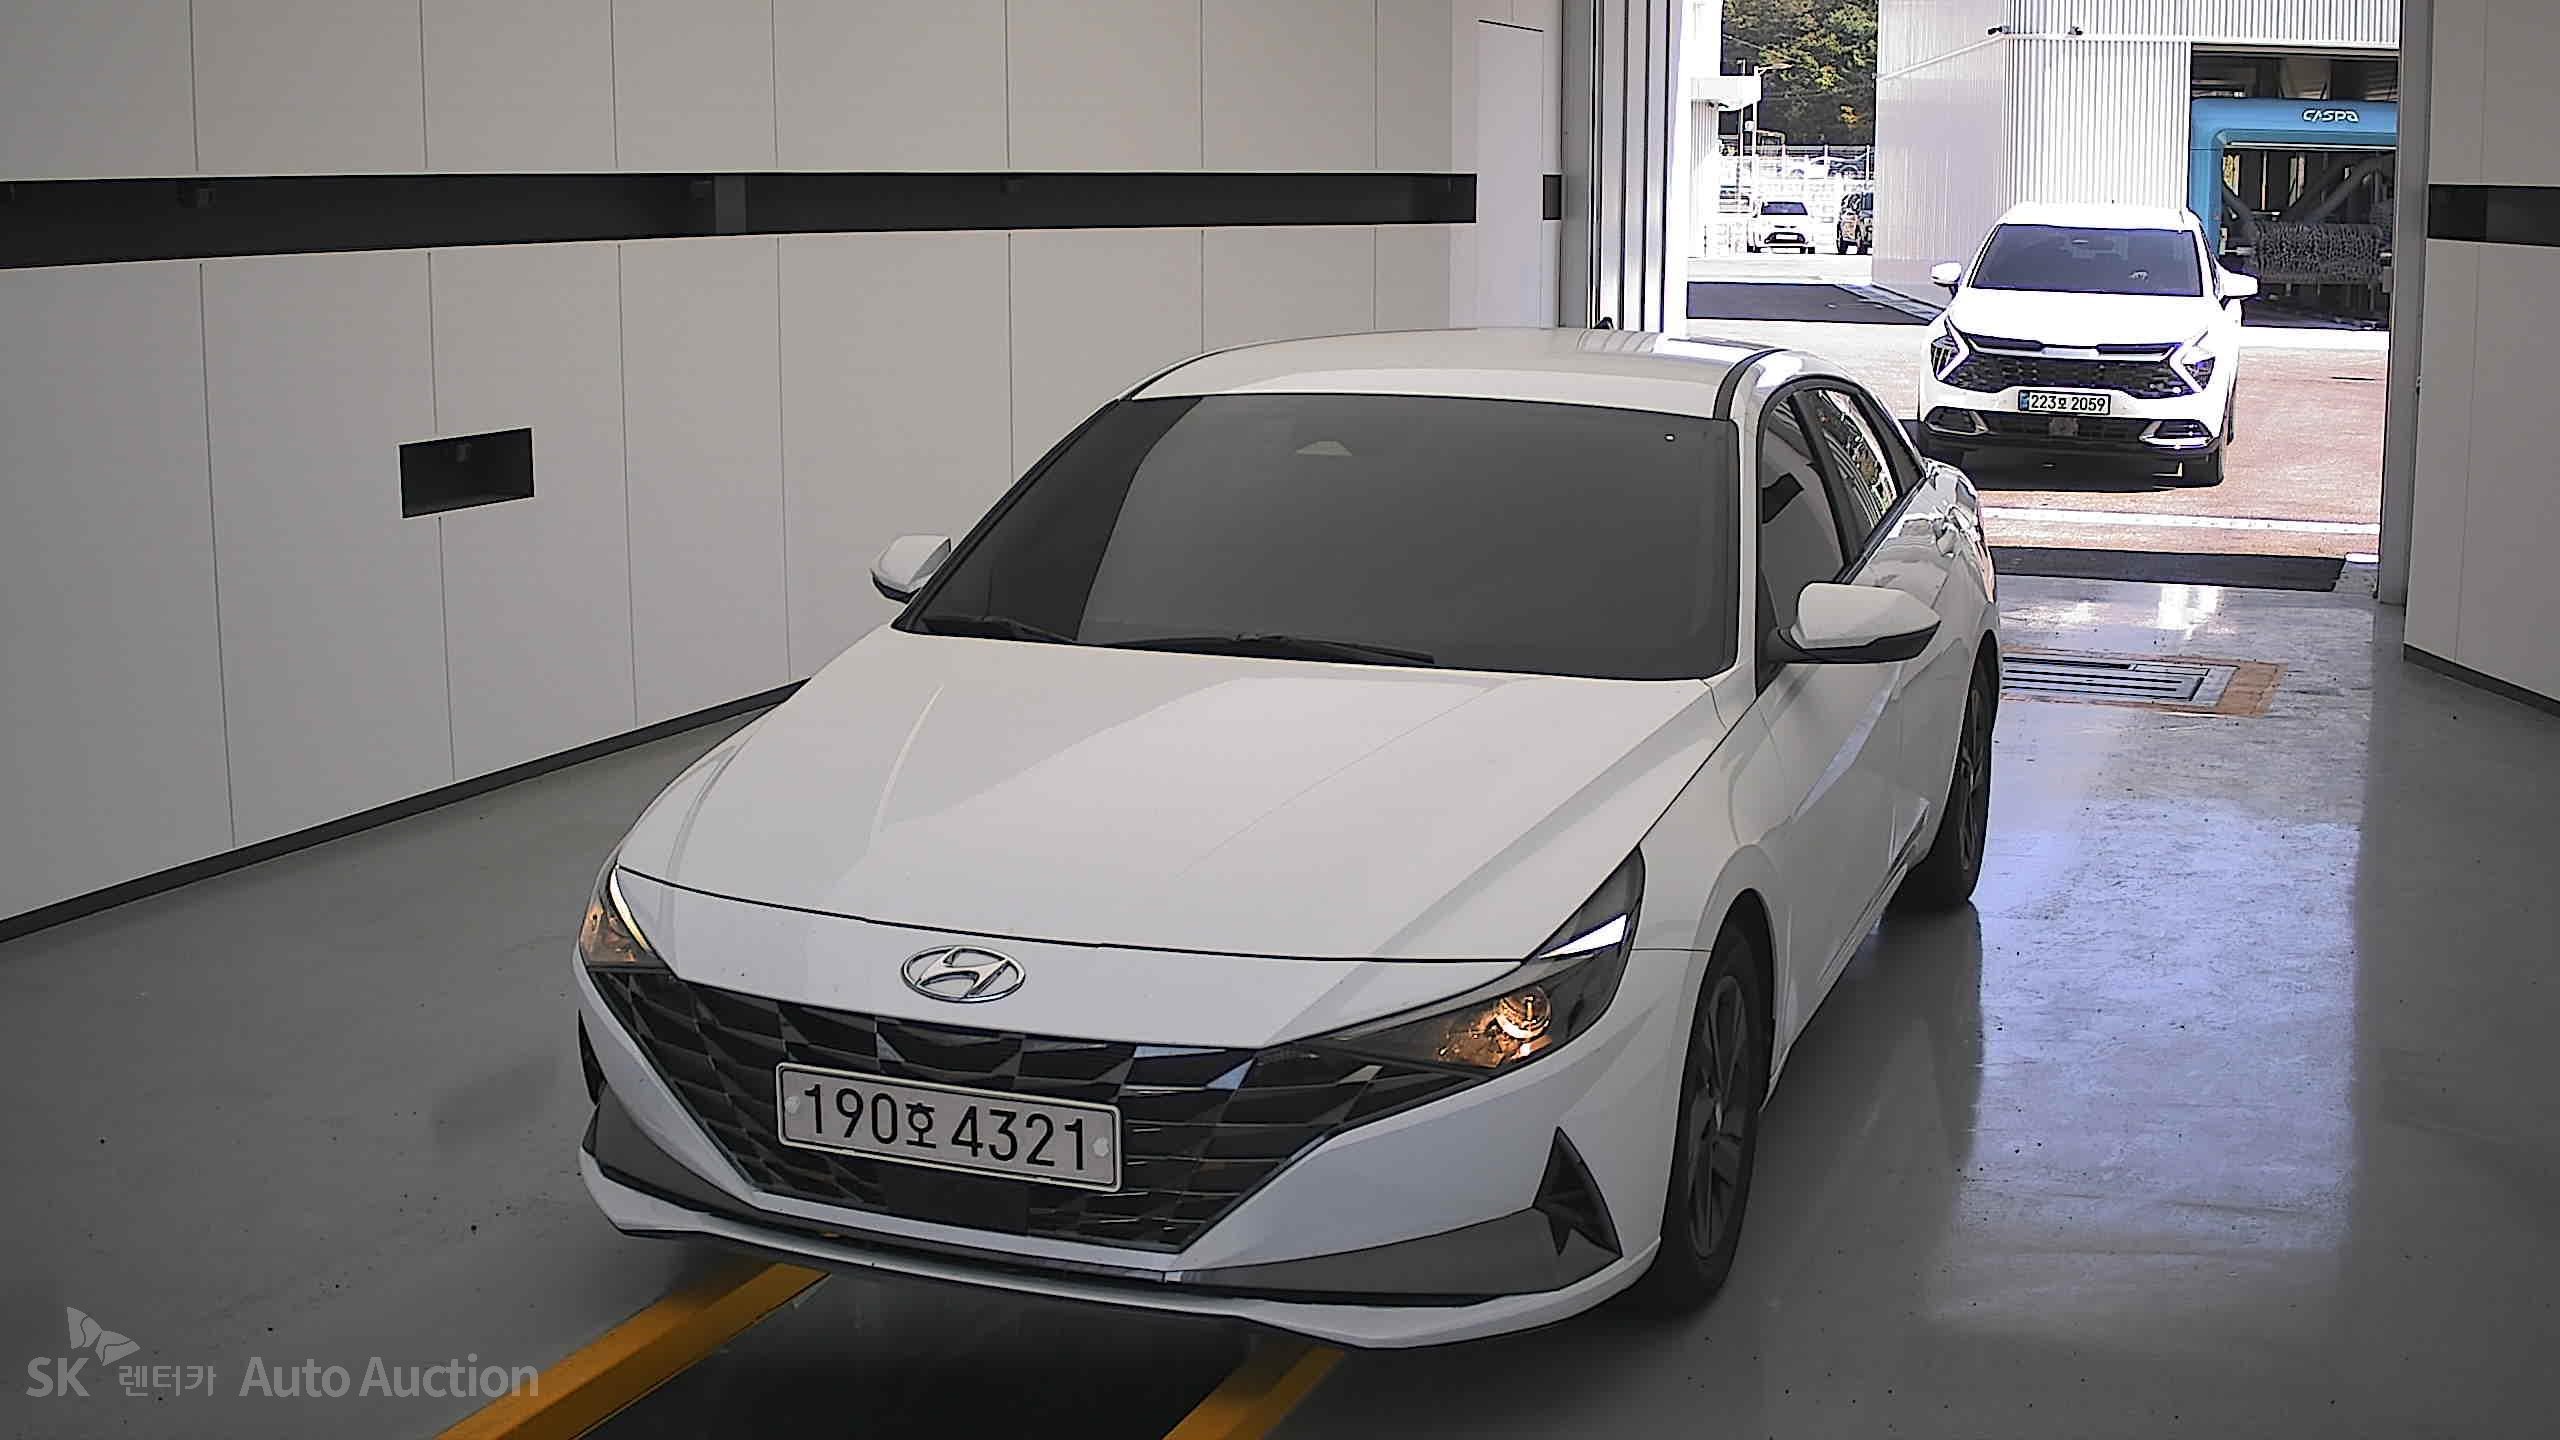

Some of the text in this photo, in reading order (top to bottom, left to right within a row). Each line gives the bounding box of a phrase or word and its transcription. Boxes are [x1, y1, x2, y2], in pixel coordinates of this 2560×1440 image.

[2071, 396, 2106, 412] 2059
[804, 1083, 1085, 1171] 190호 4321
